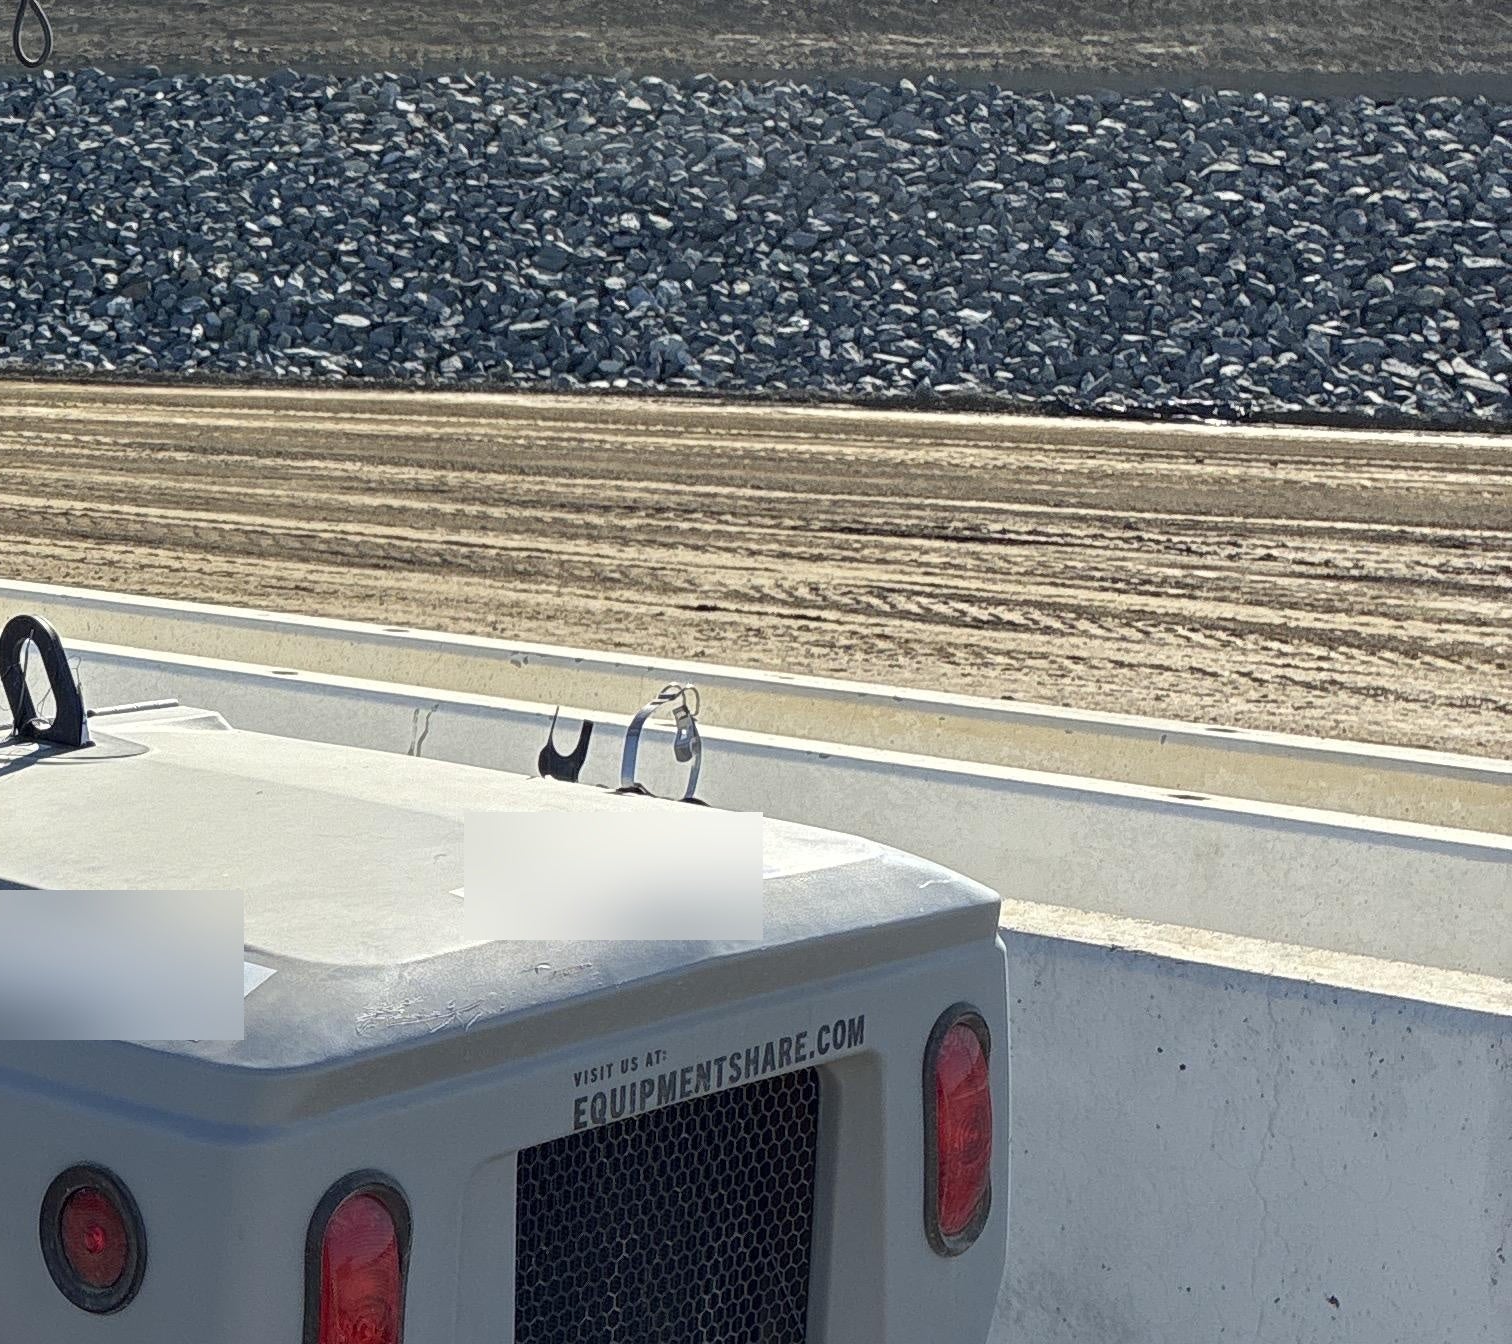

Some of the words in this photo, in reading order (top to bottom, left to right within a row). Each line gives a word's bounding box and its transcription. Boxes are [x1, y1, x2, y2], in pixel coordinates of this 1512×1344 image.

[572, 1014, 866, 1131] EQUIPMENTSHARE.COM
[573, 1062, 614, 1088] VISIT
[620, 1056, 639, 1075] US
[644, 1049, 668, 1069] AT:
